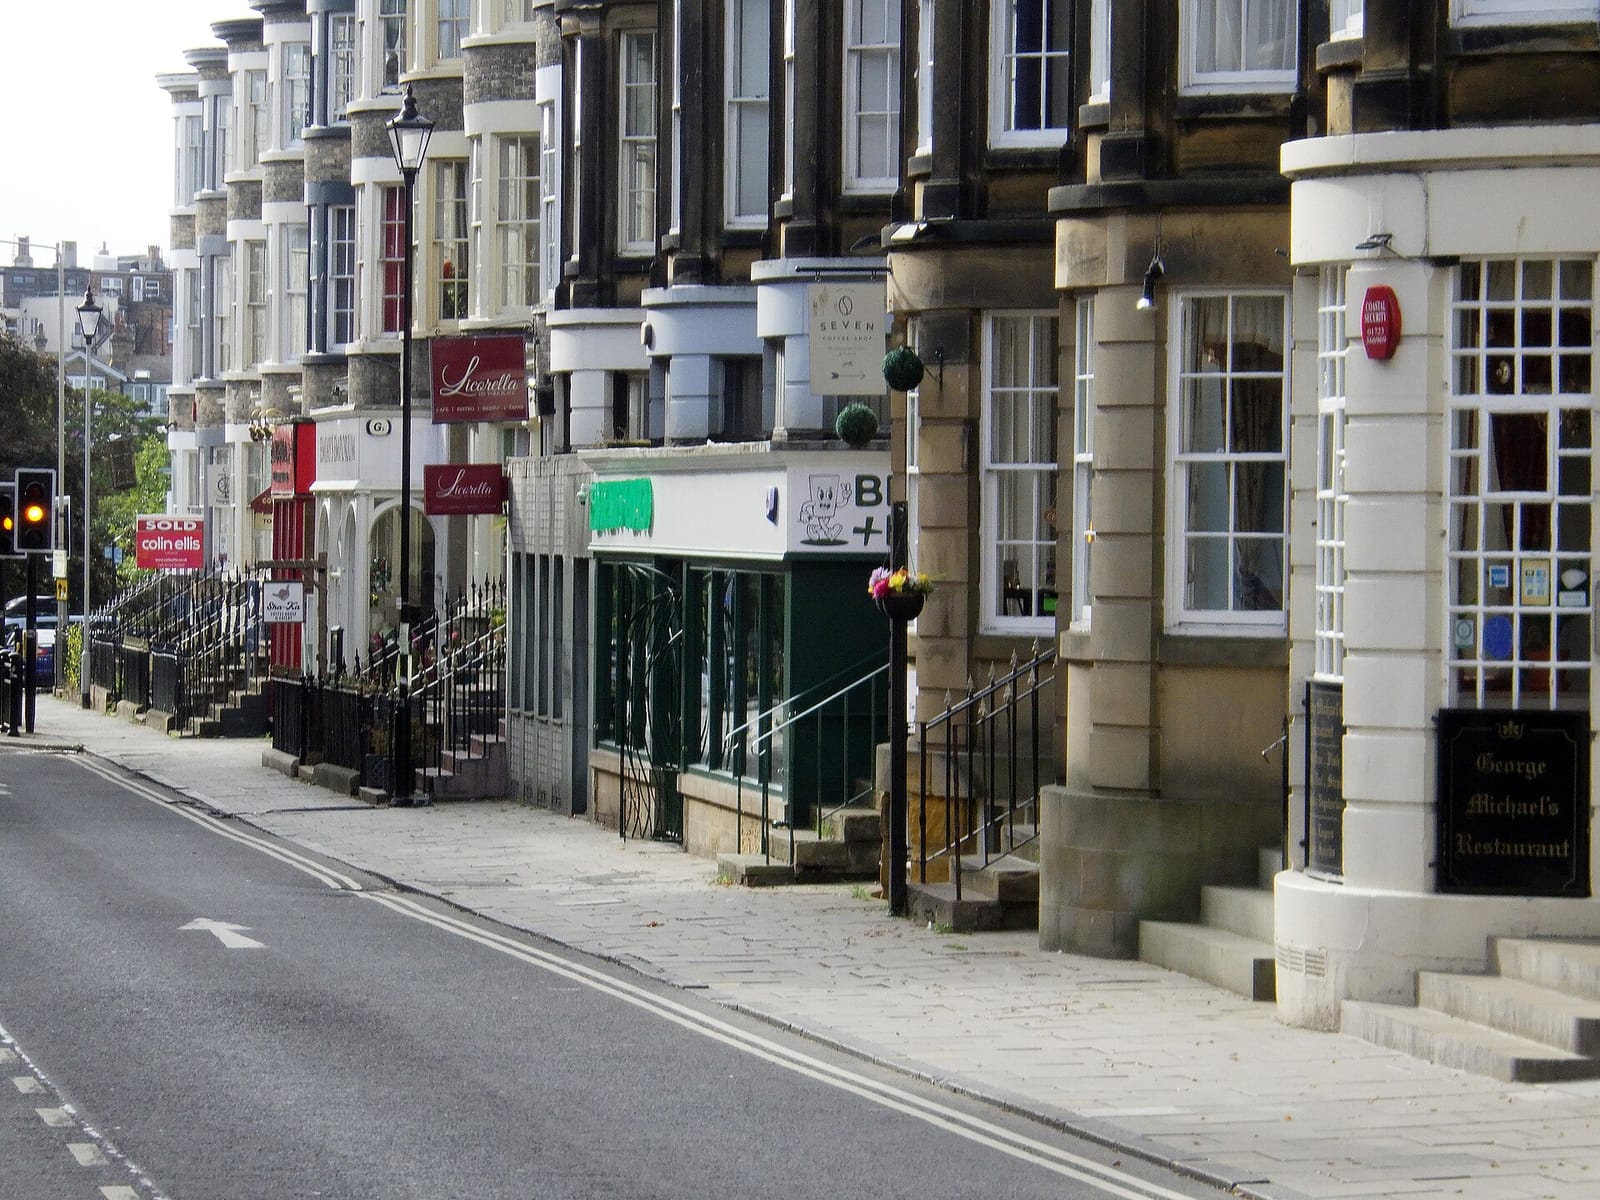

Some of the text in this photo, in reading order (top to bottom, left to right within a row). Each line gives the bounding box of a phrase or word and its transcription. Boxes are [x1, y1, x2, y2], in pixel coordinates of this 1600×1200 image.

[1365, 300, 1386, 311] COASTAL
[820, 320, 874, 331] SEVEN
[1364, 311, 1386, 323] SECURITY
[440, 355, 519, 397] Licorella
[436, 468, 493, 498] Licorella
[145, 520, 197, 531] SOLD
[142, 535, 200, 550] colin ellis
[1476, 752, 1547, 781] George
[1465, 792, 1560, 821] Michael's
[1455, 833, 1569, 857] Restaurant
